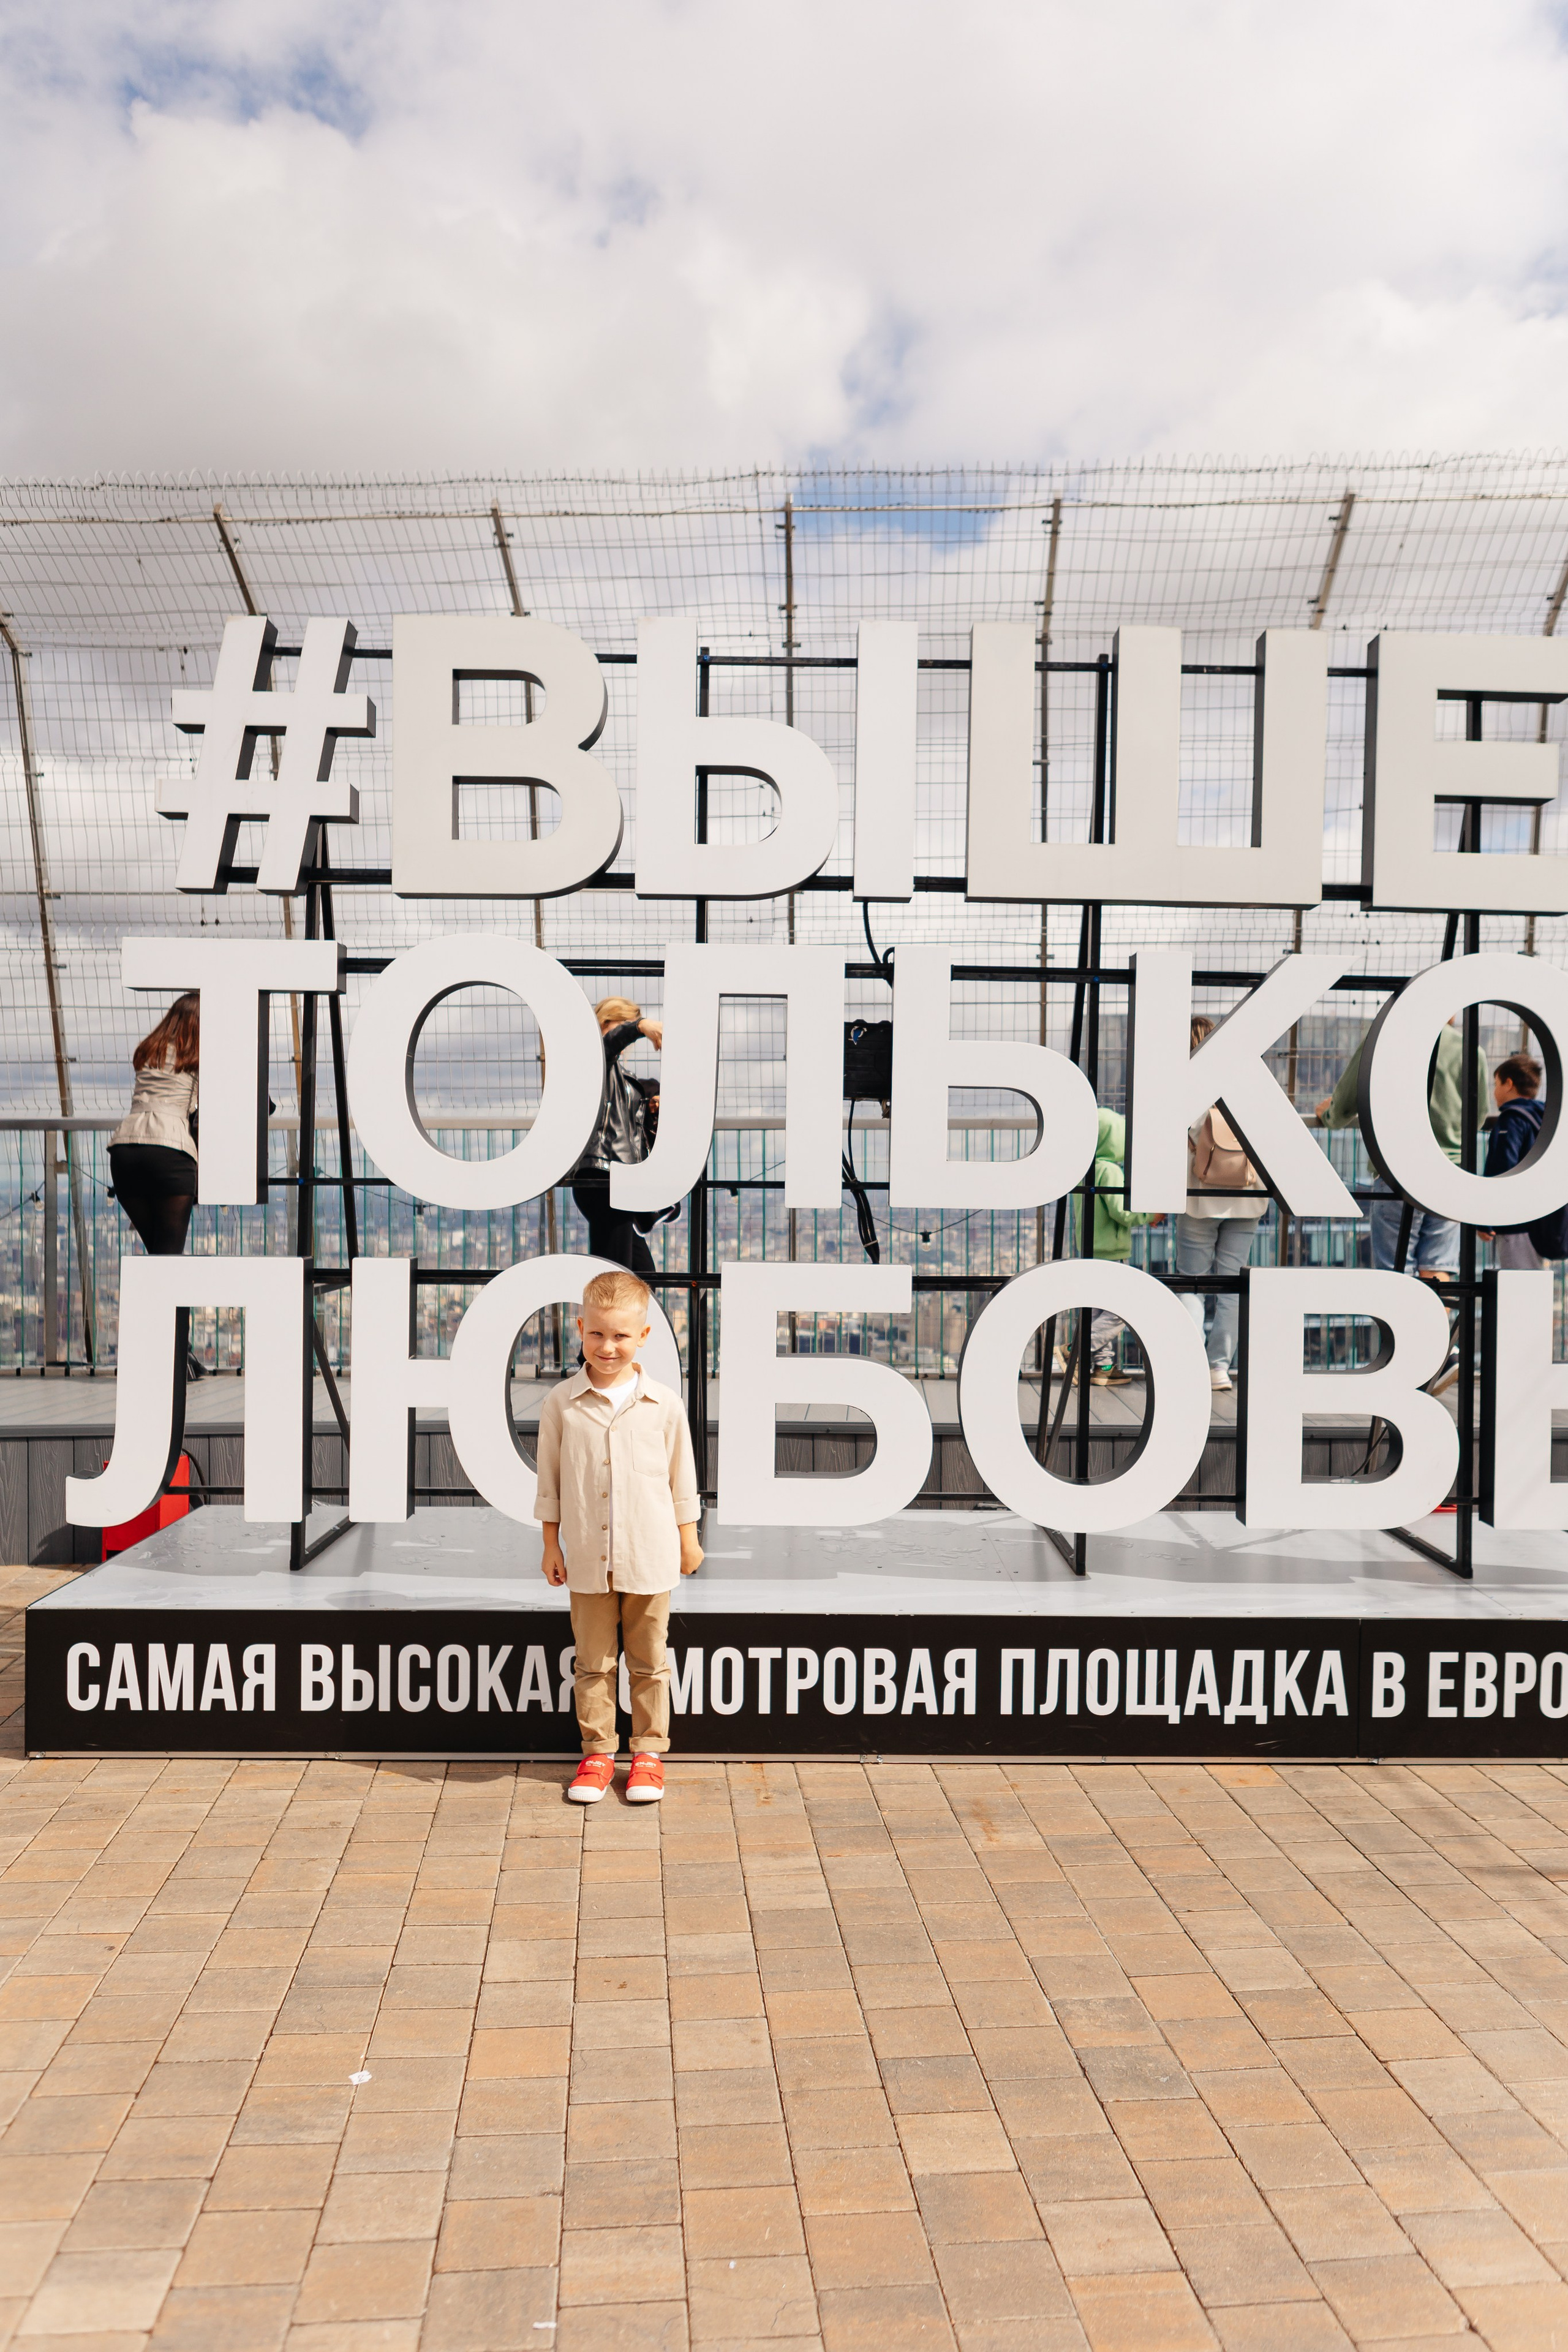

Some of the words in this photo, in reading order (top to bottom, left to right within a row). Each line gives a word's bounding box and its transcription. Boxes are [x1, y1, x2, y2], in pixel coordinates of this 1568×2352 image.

[154, 614, 1568, 915] #ВЫШЕ
[123, 932, 1568, 1226] ТОЛЬКО
[67, 1643, 276, 1711] САМАЯ
[1000, 1648, 1349, 1724] ПЛОЩАДКА
[1371, 1652, 1406, 1718] В
[1428, 1652, 1568, 1719] ЕВРО
